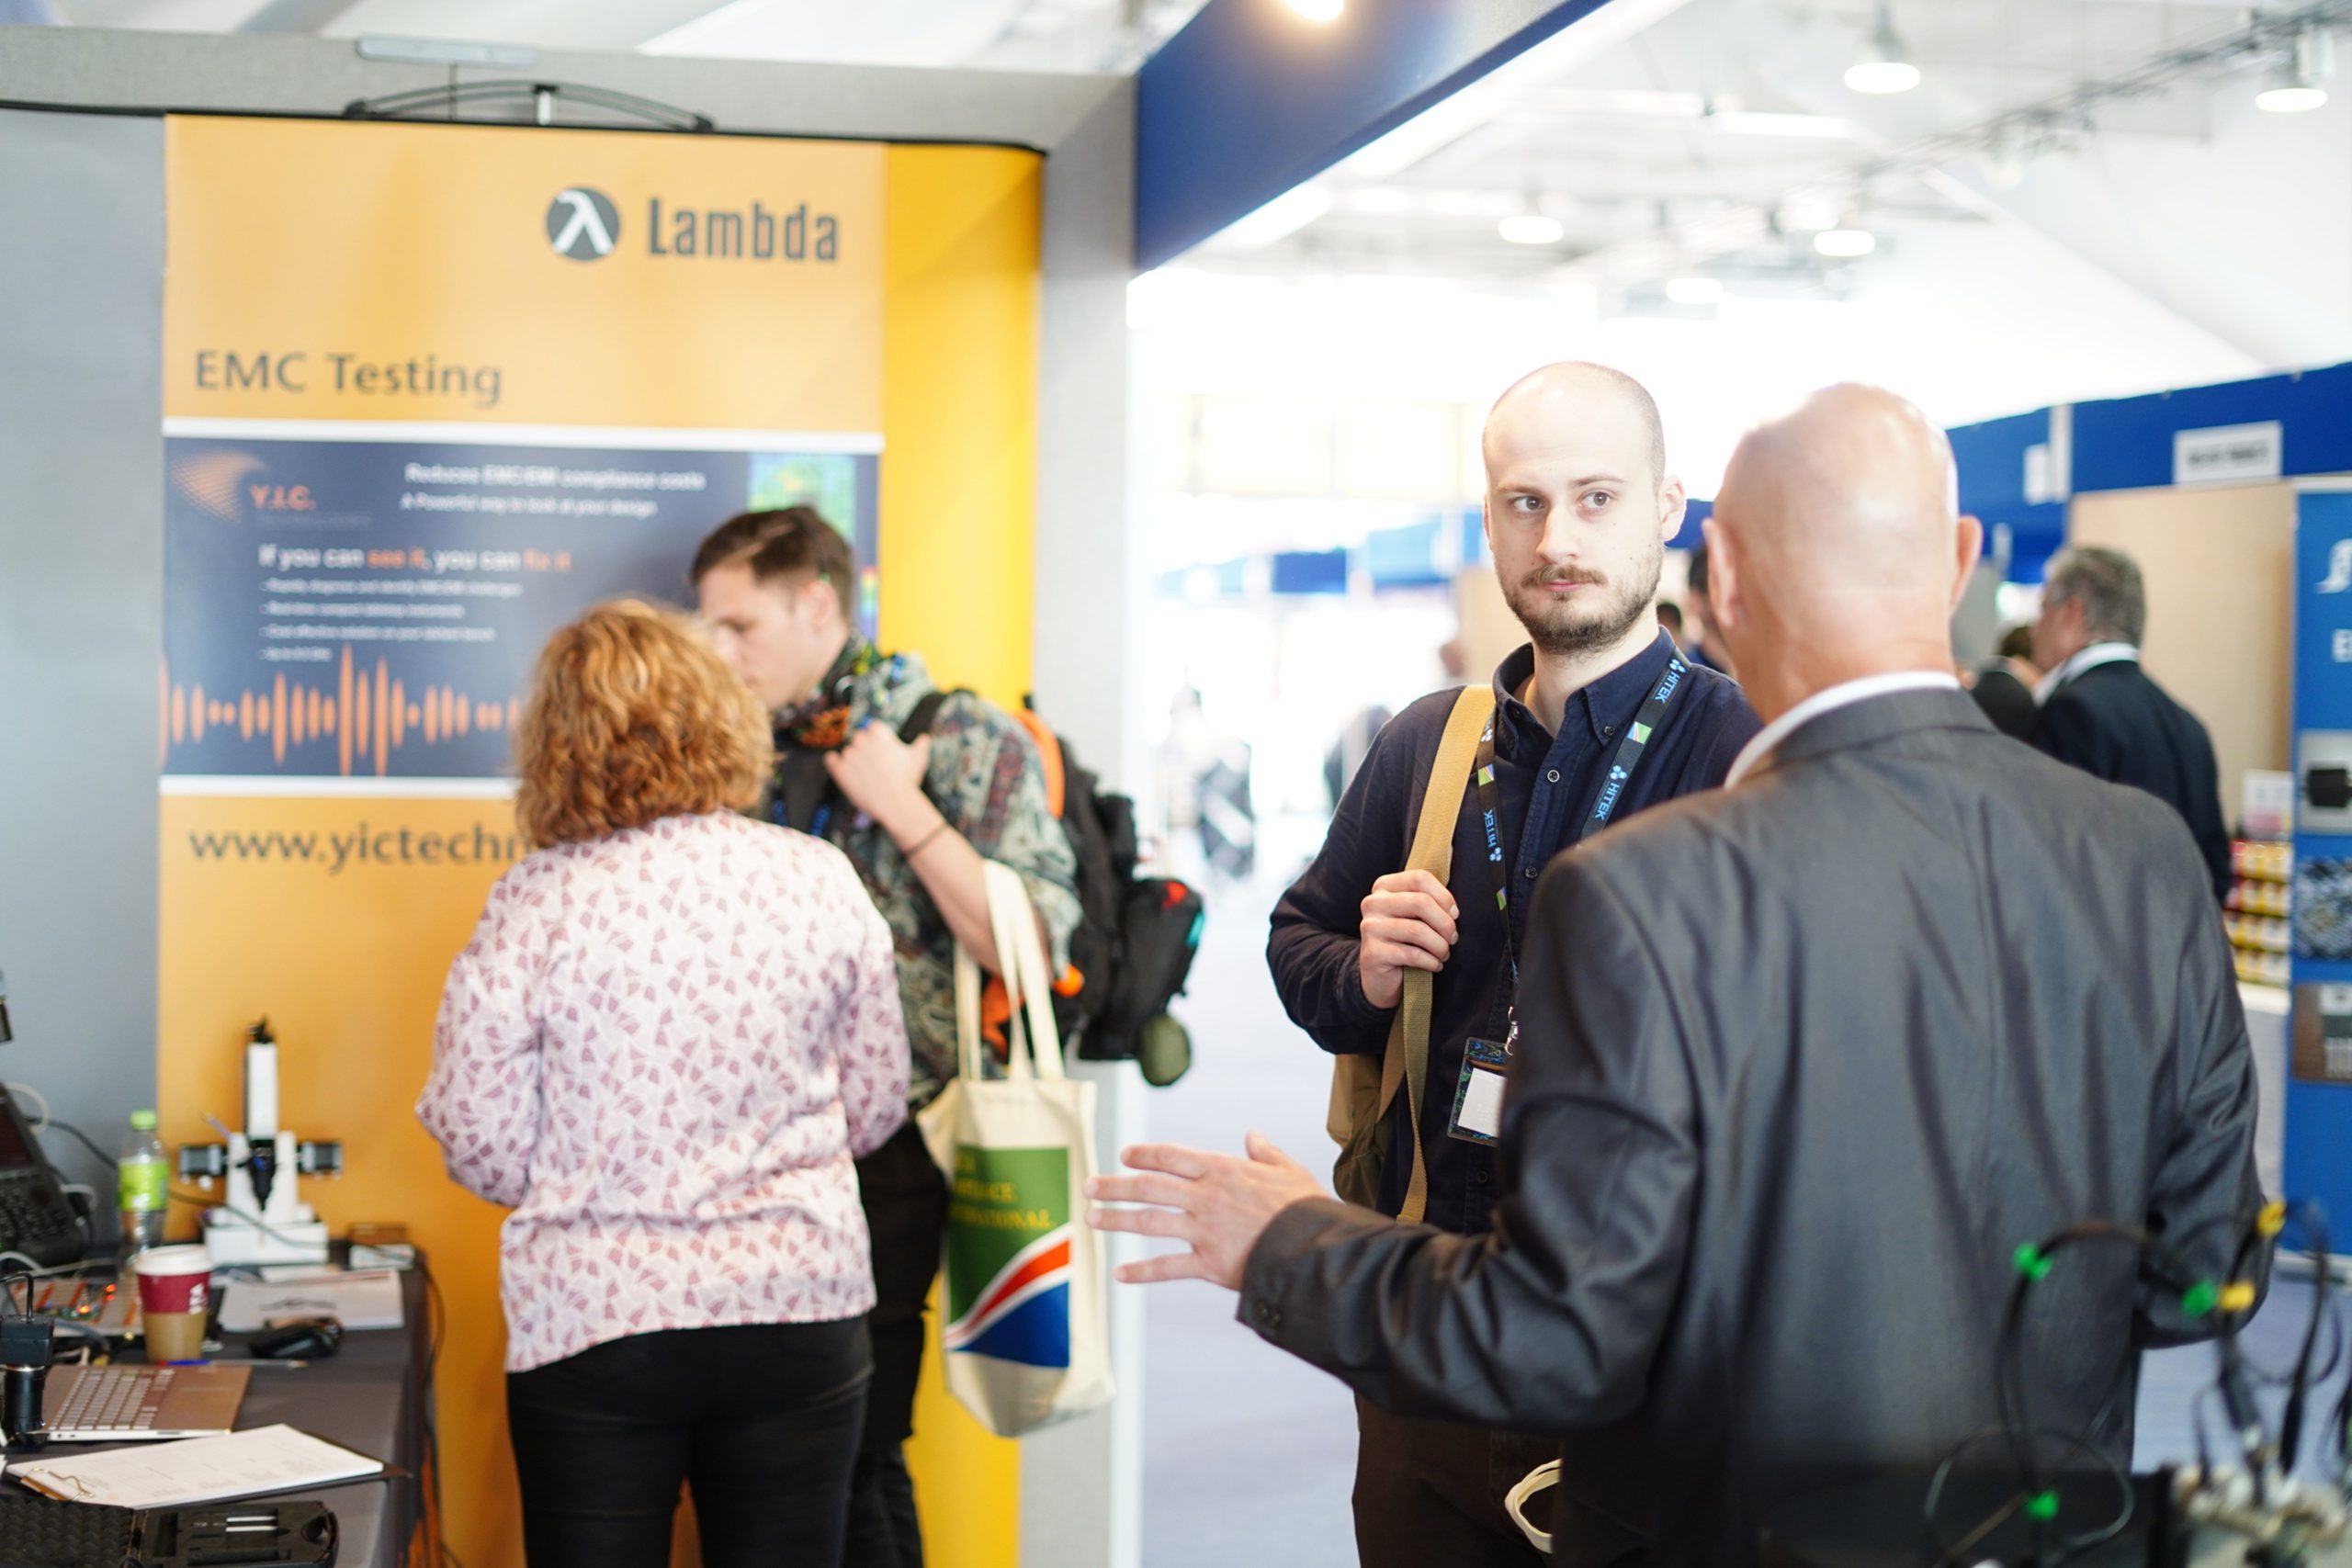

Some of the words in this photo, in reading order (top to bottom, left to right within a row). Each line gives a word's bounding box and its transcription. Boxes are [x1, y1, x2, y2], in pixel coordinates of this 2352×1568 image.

[647, 196, 840, 263] Lambda
[195, 349, 308, 393] EMC
[325, 353, 503, 409] Testing
[1654, 671, 1680, 705] HITEK
[1594, 782, 1621, 820] HITEK
[1483, 808, 1497, 849] HITEK
